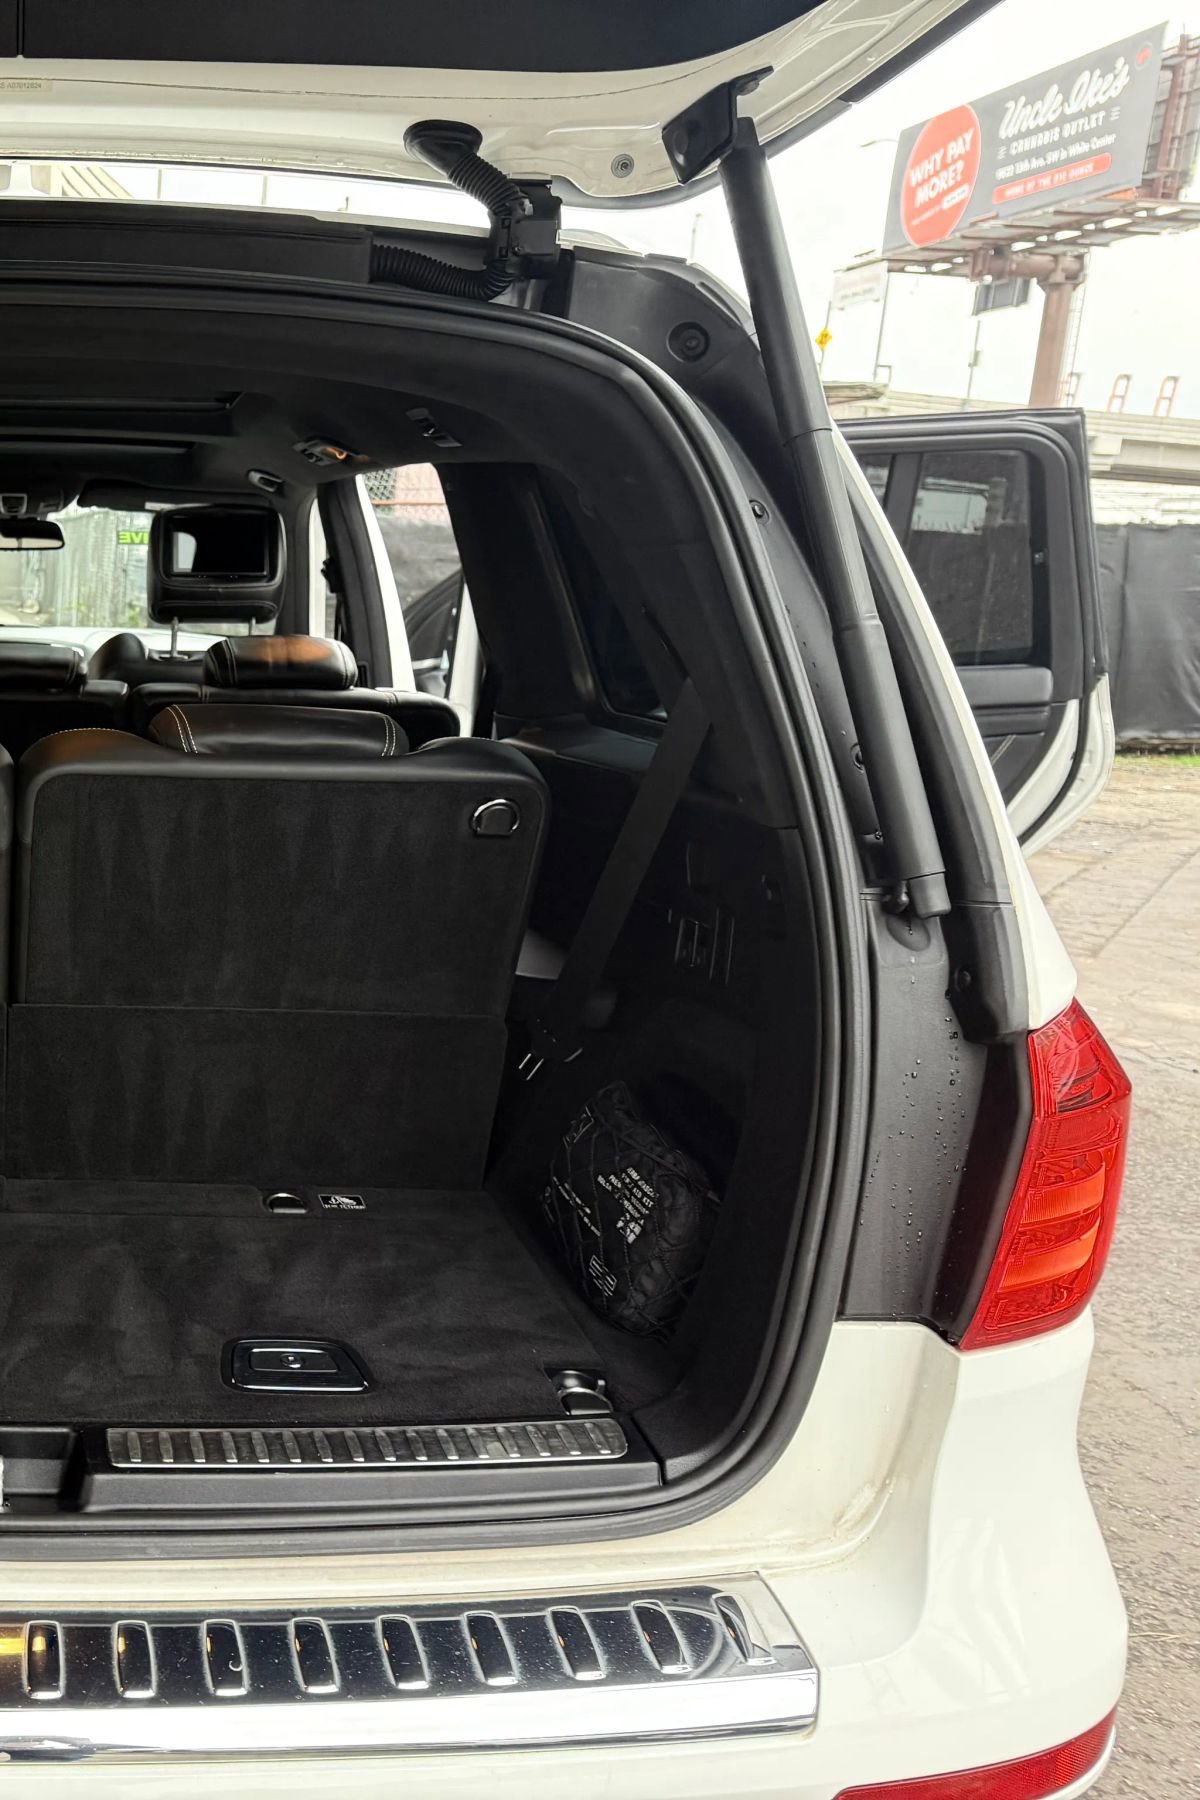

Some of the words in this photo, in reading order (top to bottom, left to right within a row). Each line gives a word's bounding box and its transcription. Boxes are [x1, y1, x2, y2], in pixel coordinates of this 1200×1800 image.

[999, 84, 1063, 139] Uncle
[1009, 126, 1061, 156] CANNABIS
[1061, 110, 1106, 138] OUTLET
[911, 147, 945, 188] WHY
[946, 127, 974, 164] PAY
[914, 160, 965, 208] MORE?
